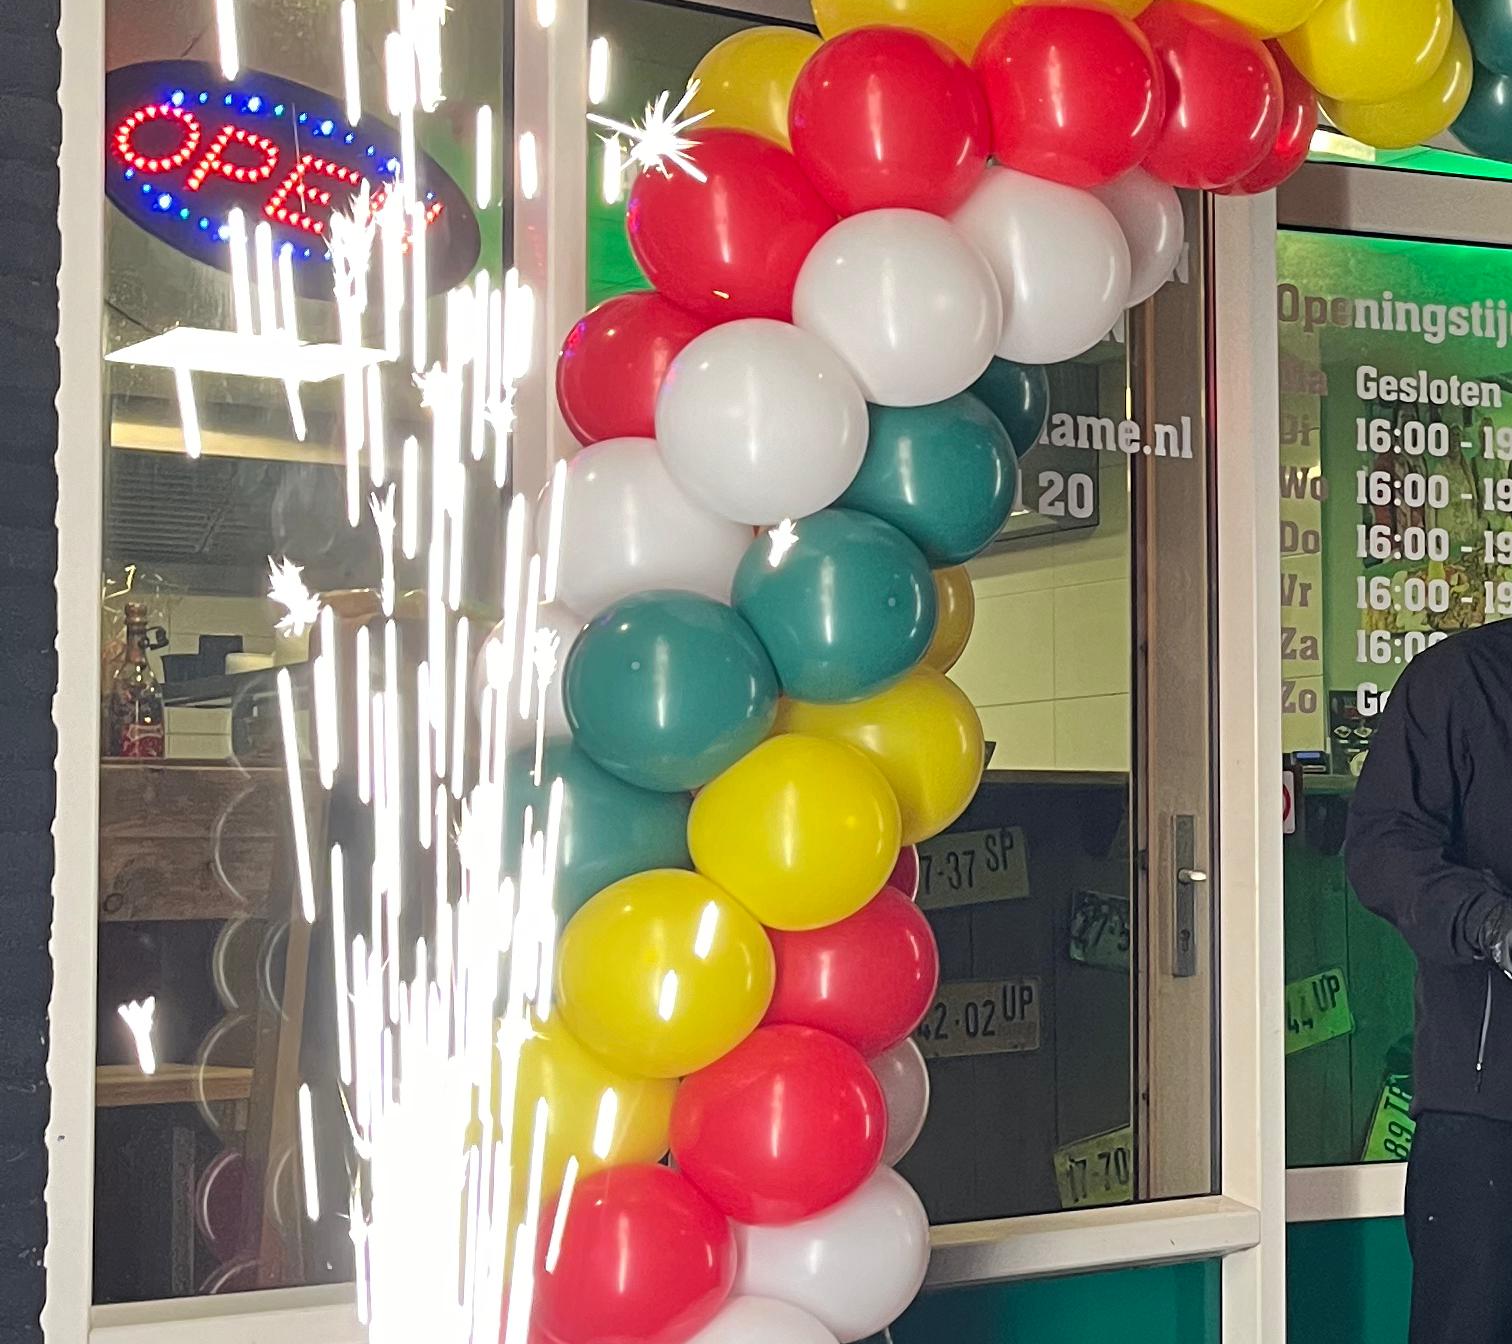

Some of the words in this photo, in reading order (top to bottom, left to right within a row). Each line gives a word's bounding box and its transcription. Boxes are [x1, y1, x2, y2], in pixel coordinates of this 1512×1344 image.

[113, 103, 444, 255] OPE
[1356, 365, 1502, 408] Gesloten
[1040, 411, 1193, 459] ame.nl
[1356, 418, 1449, 456] 16:00
[1038, 470, 1094, 518] 20
[1279, 466, 1329, 502] Wo
[1356, 471, 1449, 508] 16:00
[1280, 520, 1320, 555] Do
[1356, 524, 1449, 561] 16:00
[1280, 573, 1312, 608] Vr
[1356, 576, 1449, 613] 16:00
[1280, 627, 1320, 661] Za
[1280, 680, 1318, 714] Zo
[1002, 984, 1033, 1022] UP
